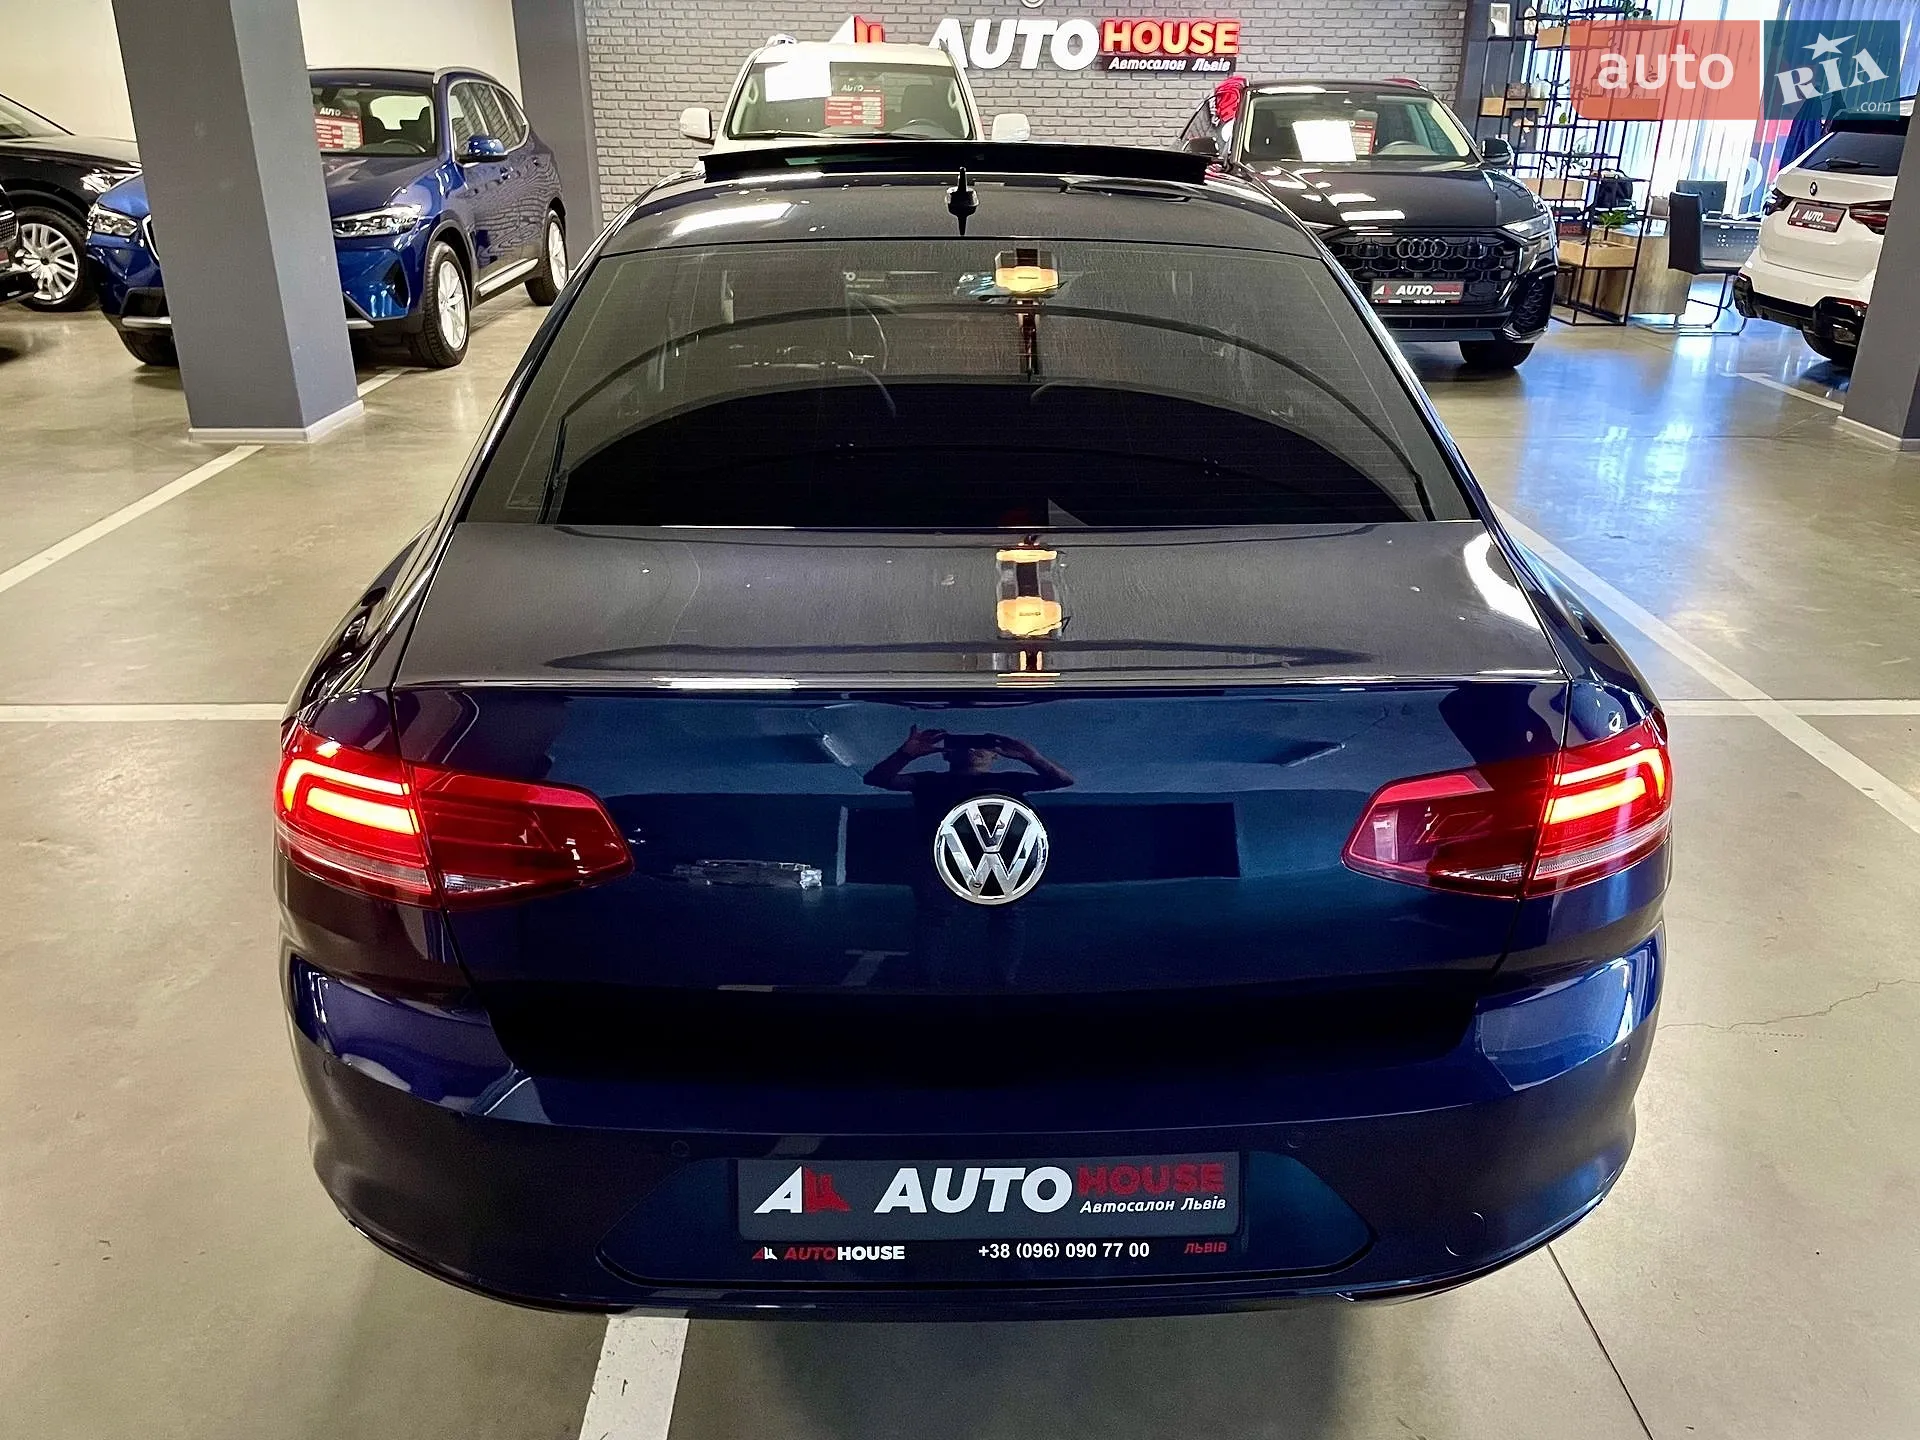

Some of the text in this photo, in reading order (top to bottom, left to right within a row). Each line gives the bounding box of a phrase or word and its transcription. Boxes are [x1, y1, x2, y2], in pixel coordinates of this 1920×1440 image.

[1102, 20, 1240, 55] HOUSE
[1108, 57, 1231, 72] Автосалон Львів
[319, 107, 342, 116] AUTO
[1802, 210, 1824, 222] AUTO
[1396, 285, 1434, 295] AUTO
[874, 1166, 1073, 1213] AUTO
[1077, 1162, 1226, 1196] HOUSE
[1080, 1195, 1226, 1214] Автосалон Львів
[978, 1242, 1150, 1259] +38 (096) 090 77 00
